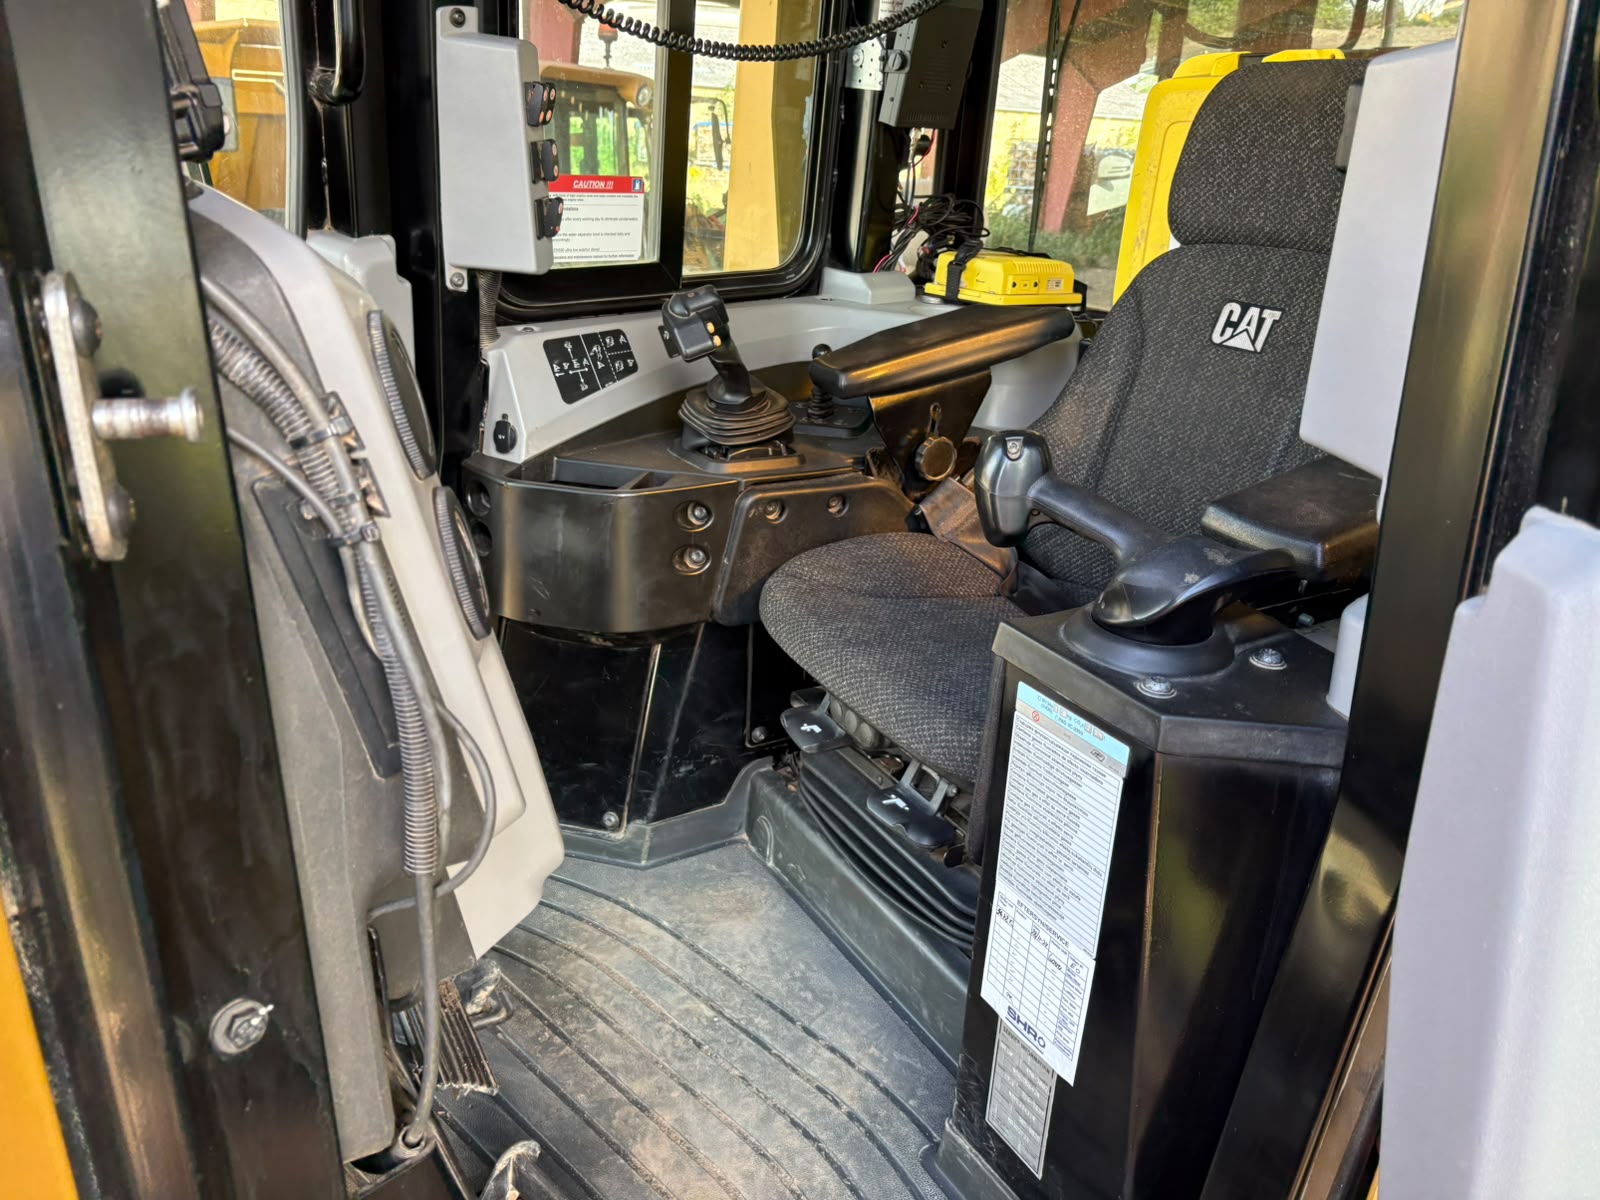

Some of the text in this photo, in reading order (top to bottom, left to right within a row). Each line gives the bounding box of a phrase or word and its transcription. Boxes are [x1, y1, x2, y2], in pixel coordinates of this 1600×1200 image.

[573, 180, 614, 189] CAUTION !!!
[1212, 302, 1282, 352] CAT
